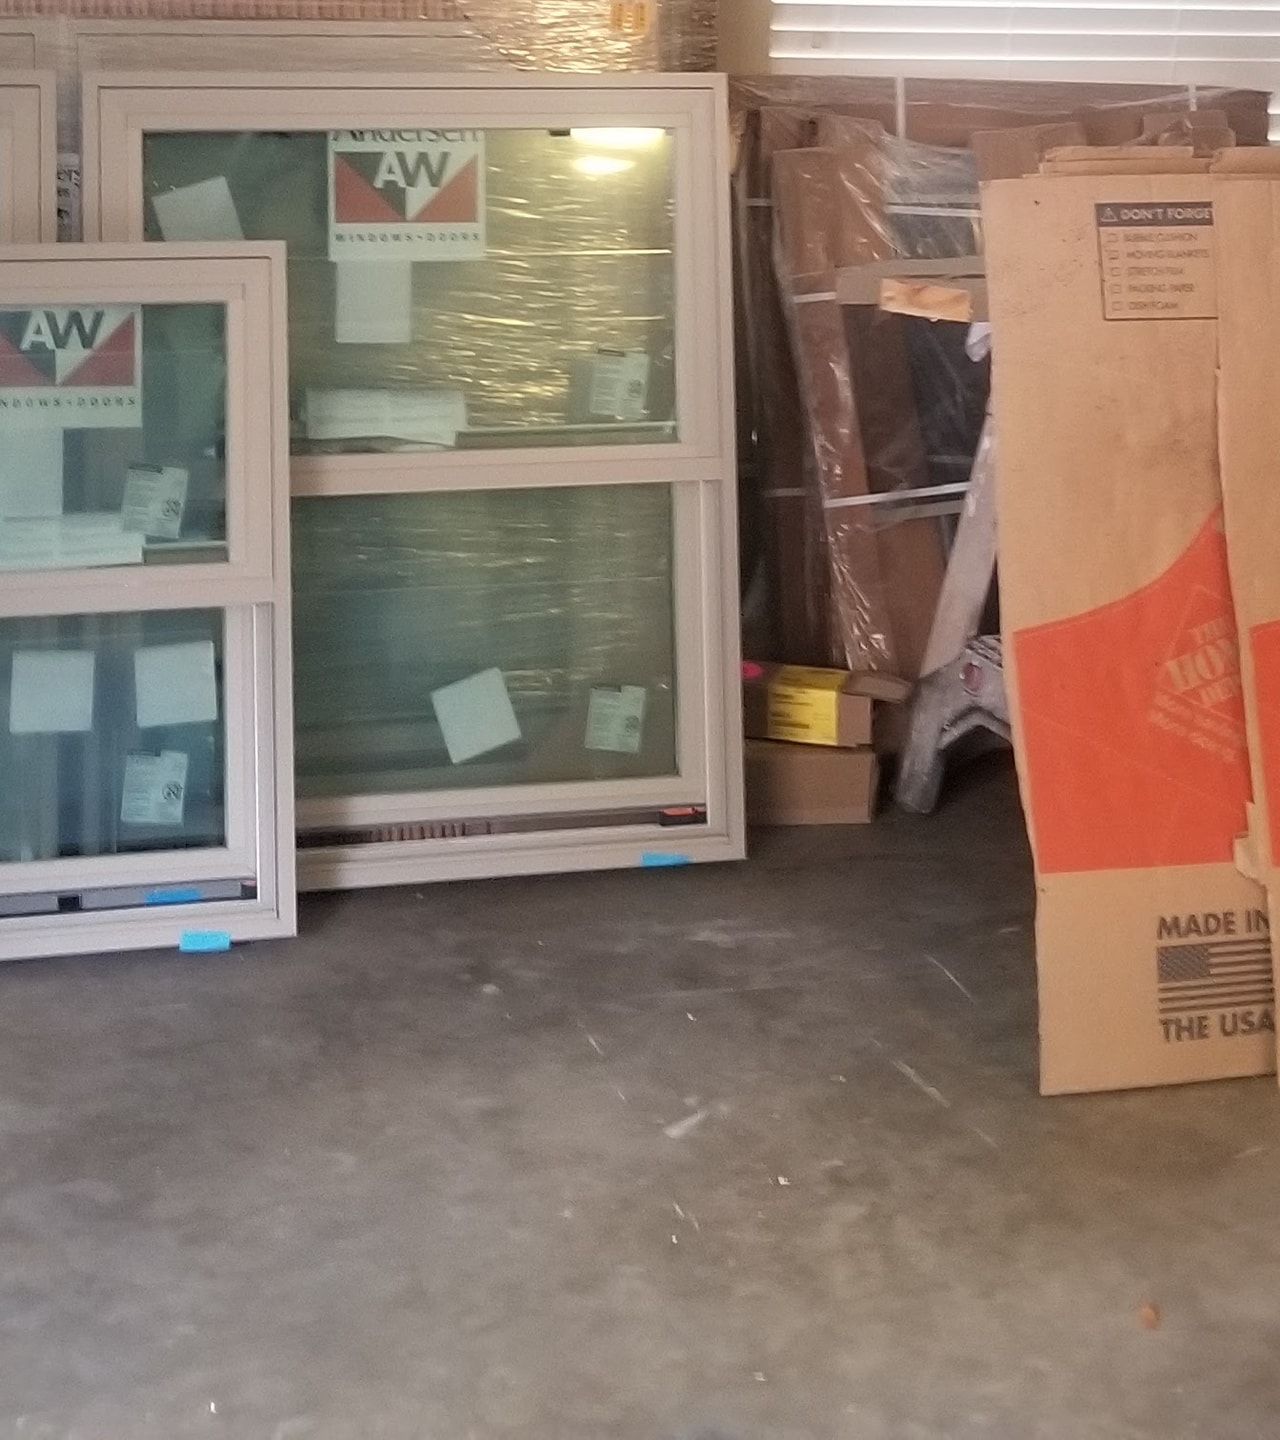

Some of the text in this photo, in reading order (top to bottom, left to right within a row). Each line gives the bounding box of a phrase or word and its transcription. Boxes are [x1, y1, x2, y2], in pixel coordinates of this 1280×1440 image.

[372, 150, 452, 189] AW
[1166, 207, 1211, 220] FORGE
[20, 310, 106, 351] AW
[1162, 637, 1241, 695] HO
[1157, 908, 1271, 940] MADE IN
[1158, 1008, 1275, 1043] THE USA
